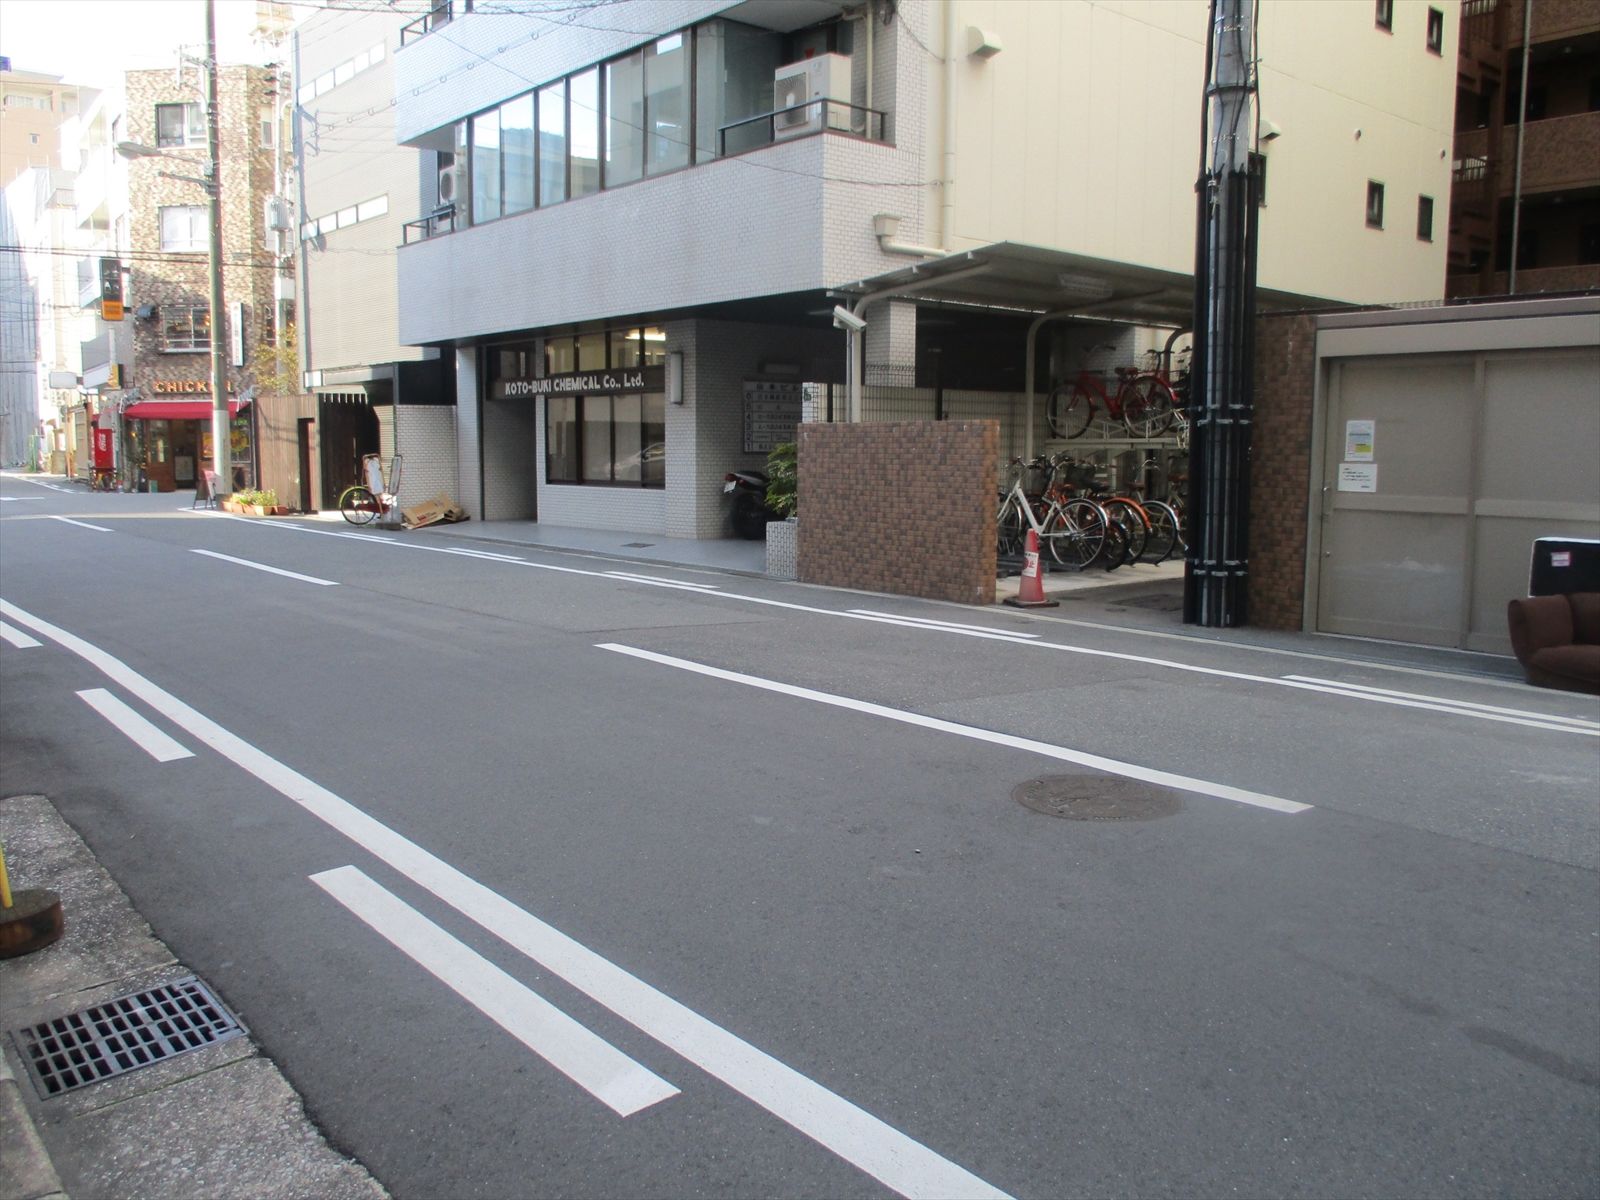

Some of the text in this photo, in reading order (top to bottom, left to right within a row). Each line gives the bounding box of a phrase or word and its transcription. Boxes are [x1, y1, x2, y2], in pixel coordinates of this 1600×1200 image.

[505, 379, 552, 395] KOTO-BUKI
[553, 375, 601, 391] CHEMICAL
[623, 372, 645, 387] Ltd.
